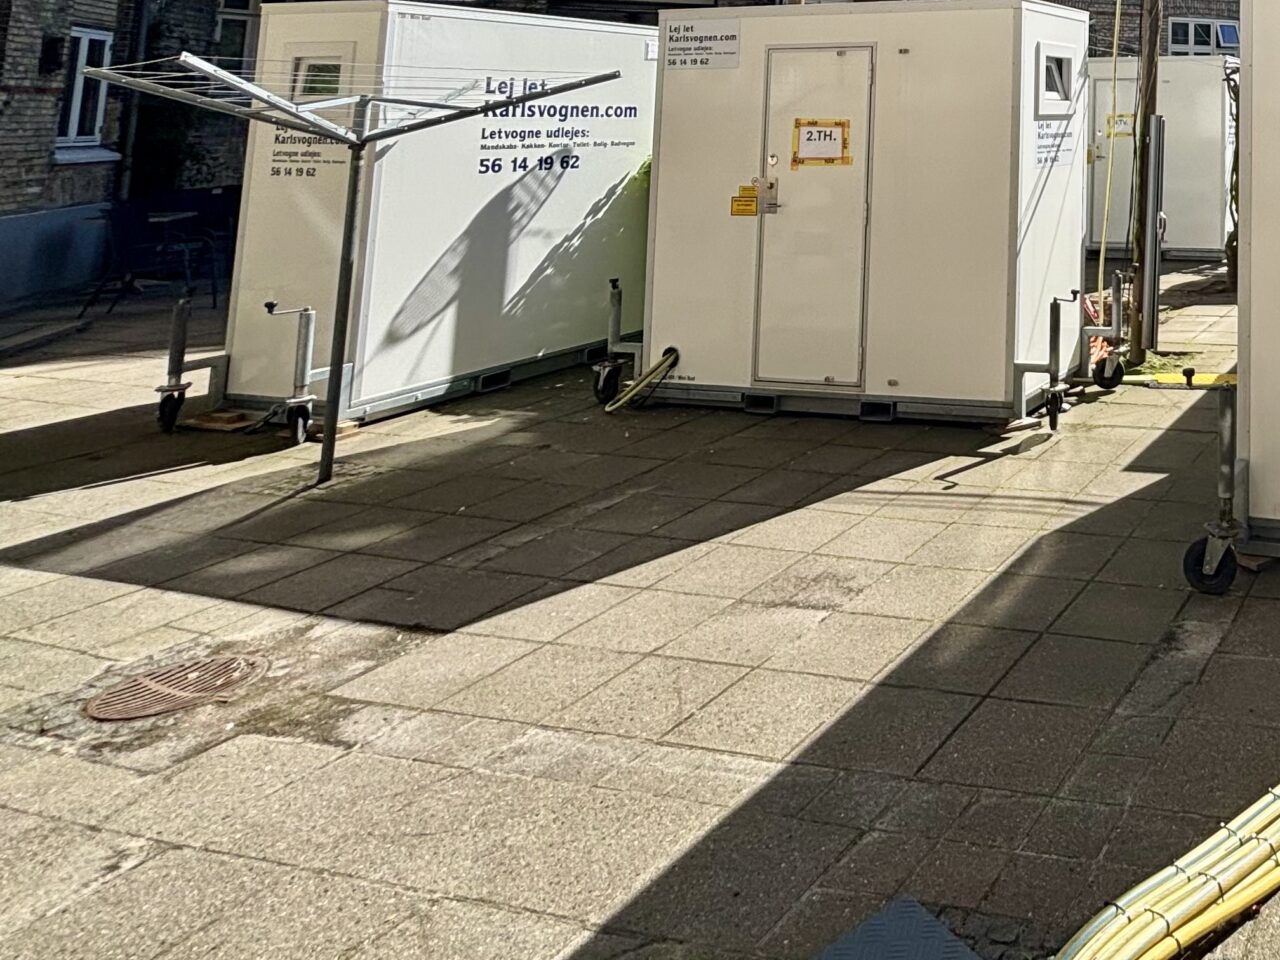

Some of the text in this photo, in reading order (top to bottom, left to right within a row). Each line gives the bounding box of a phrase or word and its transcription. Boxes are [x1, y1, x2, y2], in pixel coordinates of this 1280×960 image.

[669, 25, 681, 34] Lej
[669, 34, 737, 44] Karlsvognen.com
[667, 58, 677, 66] 56
[680, 58, 687, 66] 14
[700, 57, 710, 65] 62
[485, 76, 548, 101] Lej let
[483, 100, 638, 122] Karlsvognen.com
[481, 127, 590, 142] Letvogne udlejes:
[806, 130, 837, 141] 2.TH.
[478, 155, 580, 174] 56 14 19 62
[271, 166, 317, 177] 56 14 19 62
